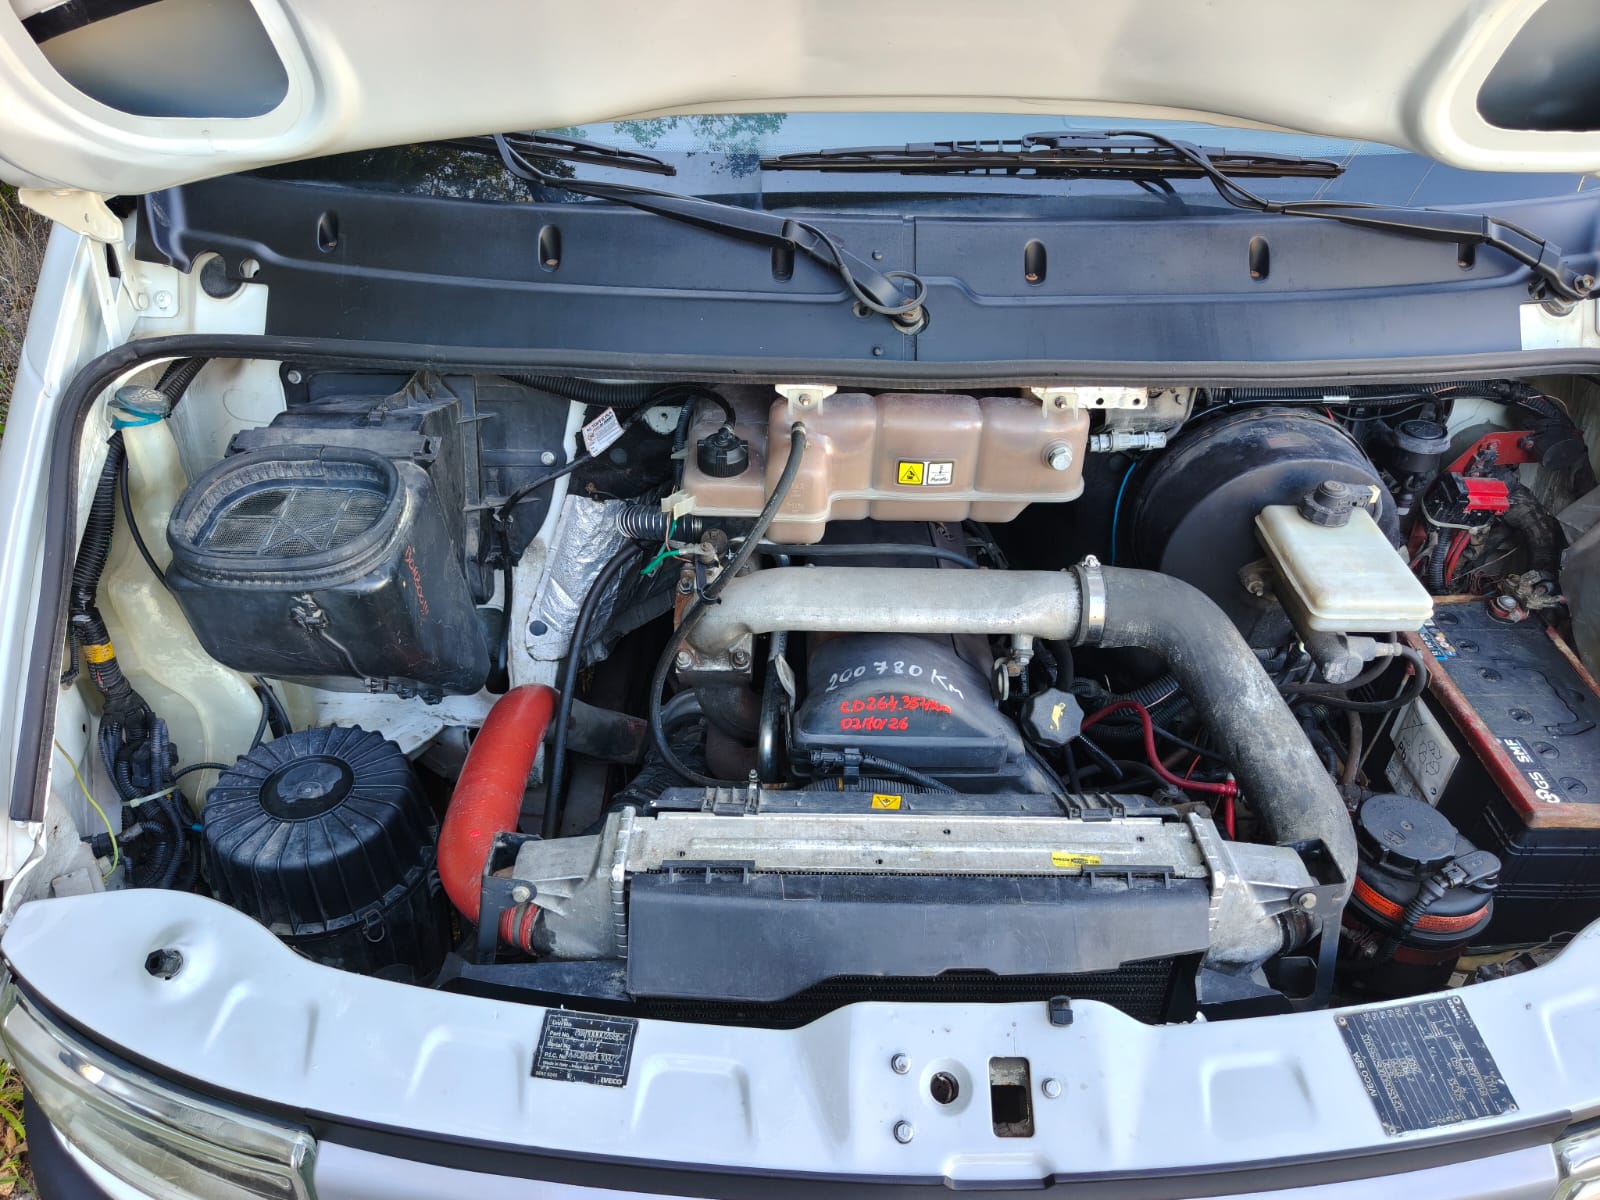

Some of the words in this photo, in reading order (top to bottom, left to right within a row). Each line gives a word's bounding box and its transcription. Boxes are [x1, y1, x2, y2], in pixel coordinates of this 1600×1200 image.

[1503, 739, 1530, 763] SMF
[1352, 1051, 1365, 1069] SPA
[600, 1077, 623, 1085] IVECO
[1360, 1069, 1378, 1097] IVECO
[1482, 1073, 1500, 1094] ITALY
